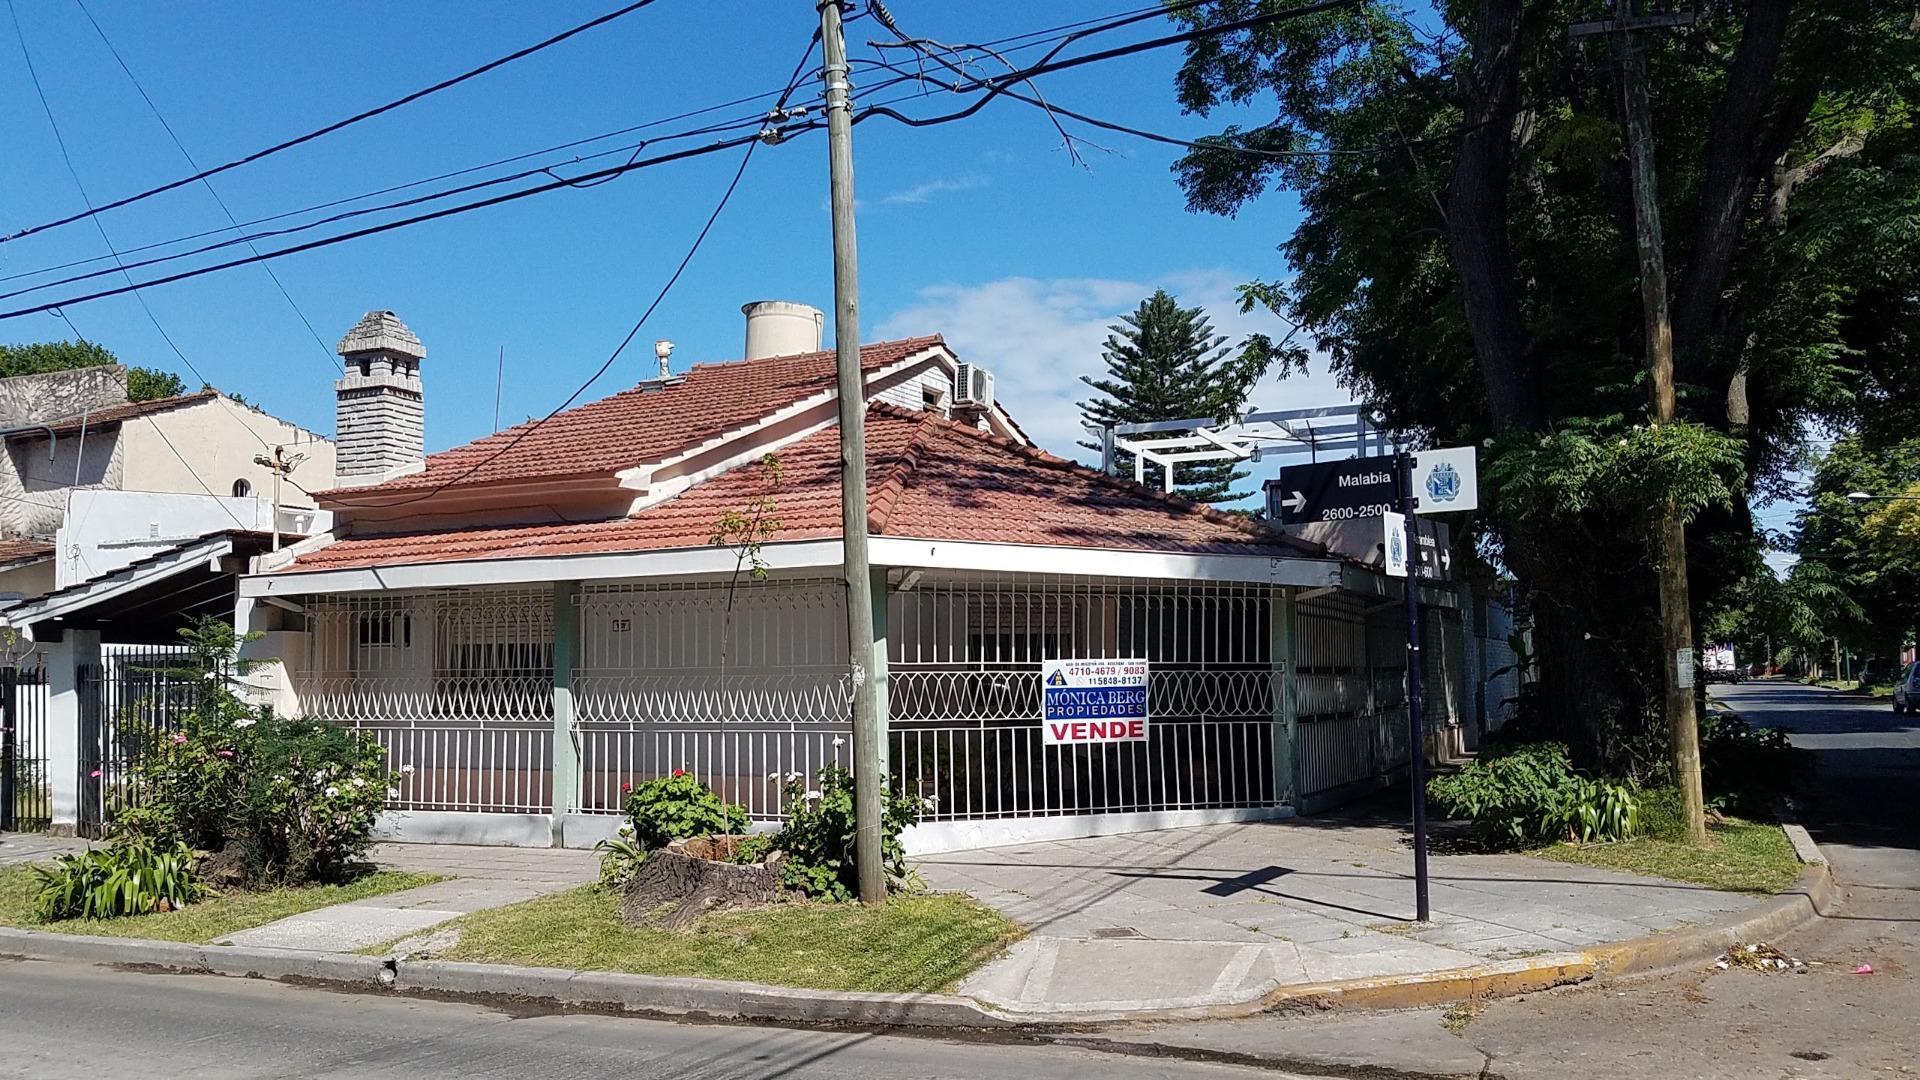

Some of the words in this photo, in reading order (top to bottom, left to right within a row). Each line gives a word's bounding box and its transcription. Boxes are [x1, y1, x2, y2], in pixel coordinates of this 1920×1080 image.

[1338, 472, 1391, 488] Malabia
[1322, 503, 1391, 521] 2600-2500
[1069, 667, 1116, 676] 4710-4679
[1123, 666, 1145, 675] 9083
[1047, 688, 1105, 706] MÓNICA
[1107, 690, 1145, 705] BERG
[1047, 704, 1144, 717] PROPIEDADES
[1050, 720, 1144, 740] VENDE
